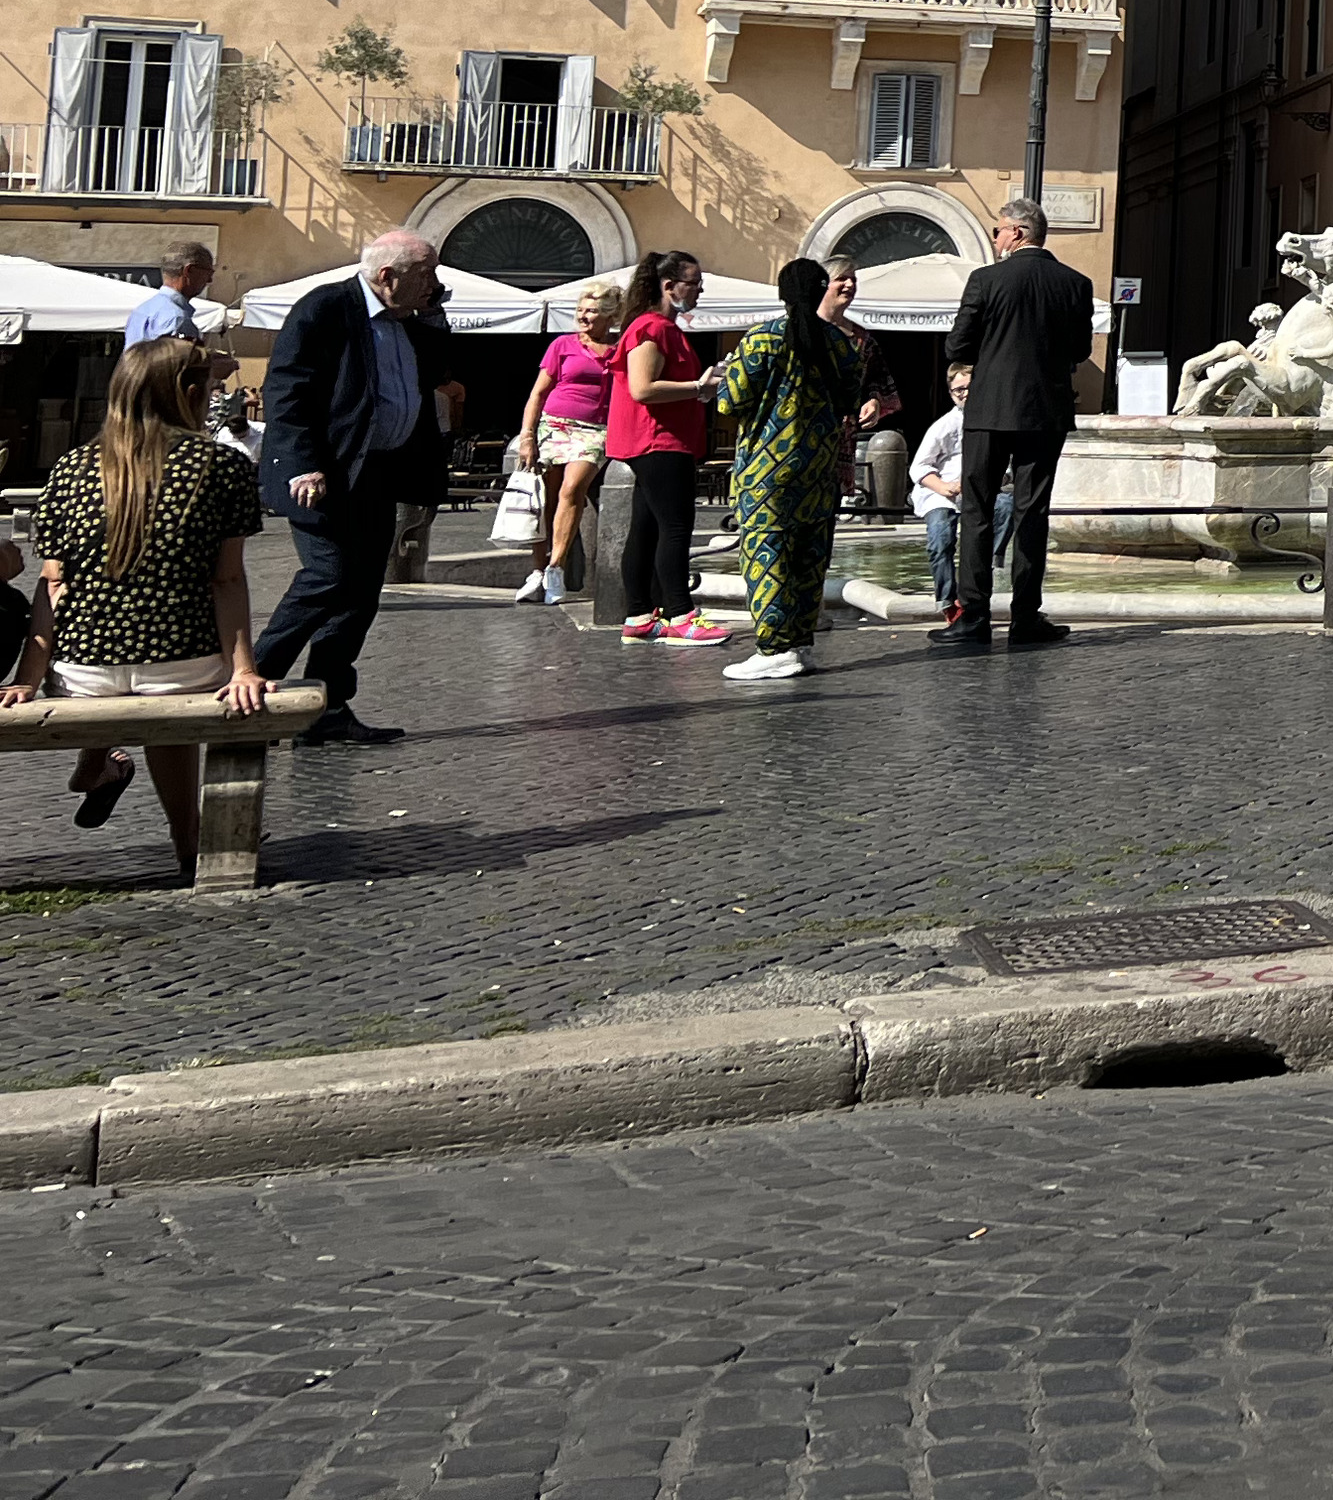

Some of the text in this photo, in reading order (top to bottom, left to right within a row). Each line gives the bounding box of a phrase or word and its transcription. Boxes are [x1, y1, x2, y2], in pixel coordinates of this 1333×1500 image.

[447, 317, 492, 329] RENDE
[862, 312, 954, 325] CUCINA ROMAN
